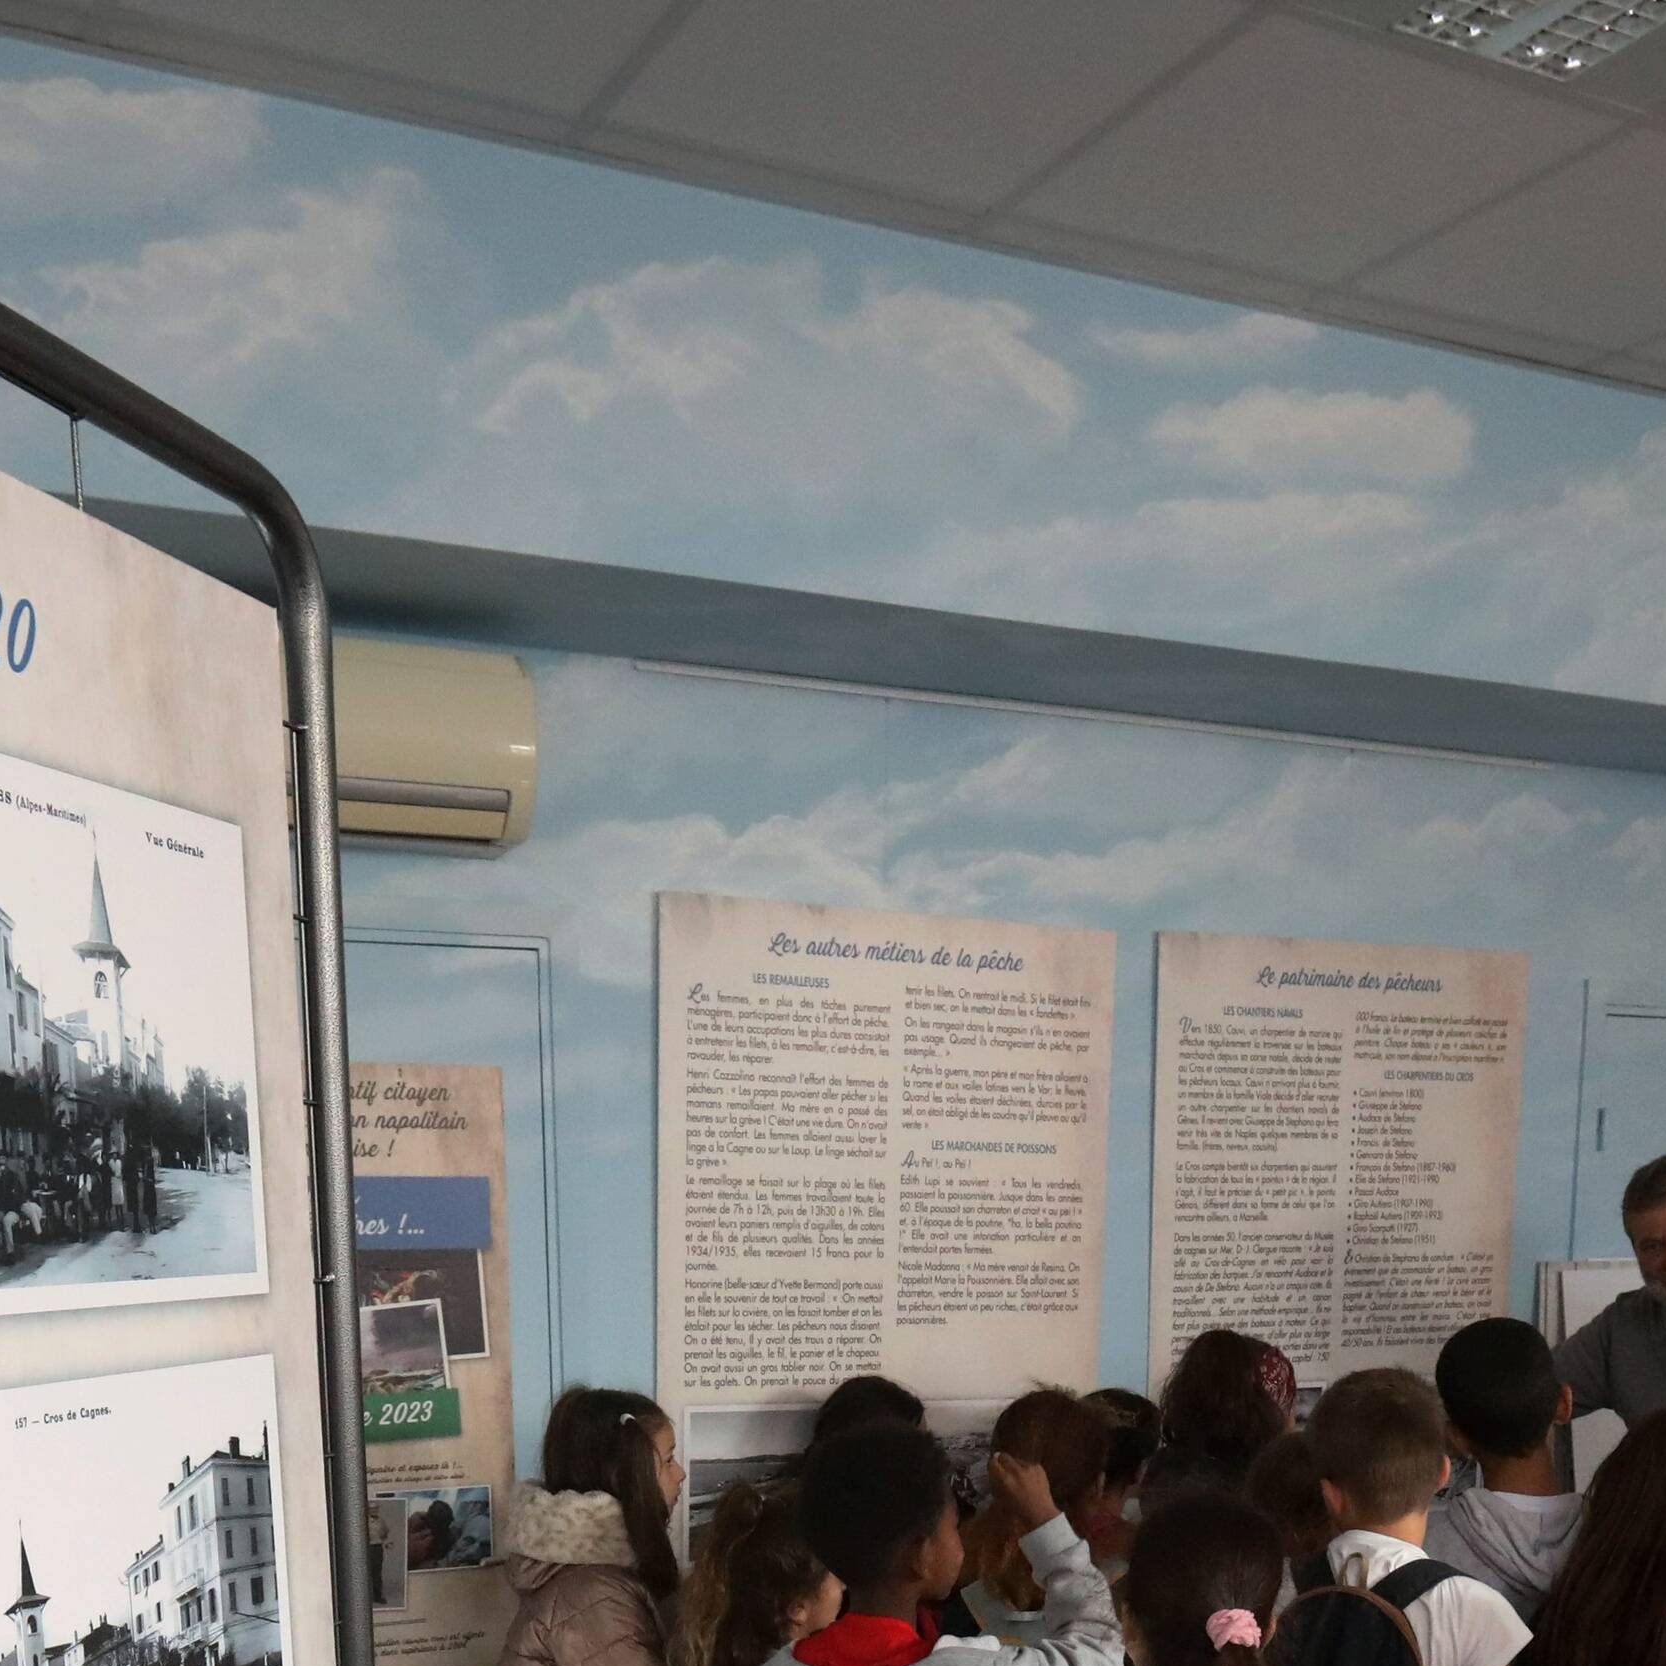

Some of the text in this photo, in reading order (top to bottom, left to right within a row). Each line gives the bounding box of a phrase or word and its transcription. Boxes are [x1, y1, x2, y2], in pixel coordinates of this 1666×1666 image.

[15, 794, 87, 827] (Alpes-Maritimes)
[145, 832, 205, 859] Vue Générale
[768, 932, 1023, 974] Les autres métiers de la pêche
[753, 973, 829, 989] LES REMAILLEUSES
[1256, 965, 1442, 993] Le patrimoine des pêcheurs
[384, 1081, 451, 1106] citoyen
[374, 1111, 467, 1134] napolitain
[932, 1140, 1057, 1154] LES MARCHANDES DE POISSONS
[14, 1417, 28, 1430] 157
[43, 1412, 64, 1425] Cros
[67, 1409, 77, 1421] de
[379, 1401, 433, 1425] 2023
